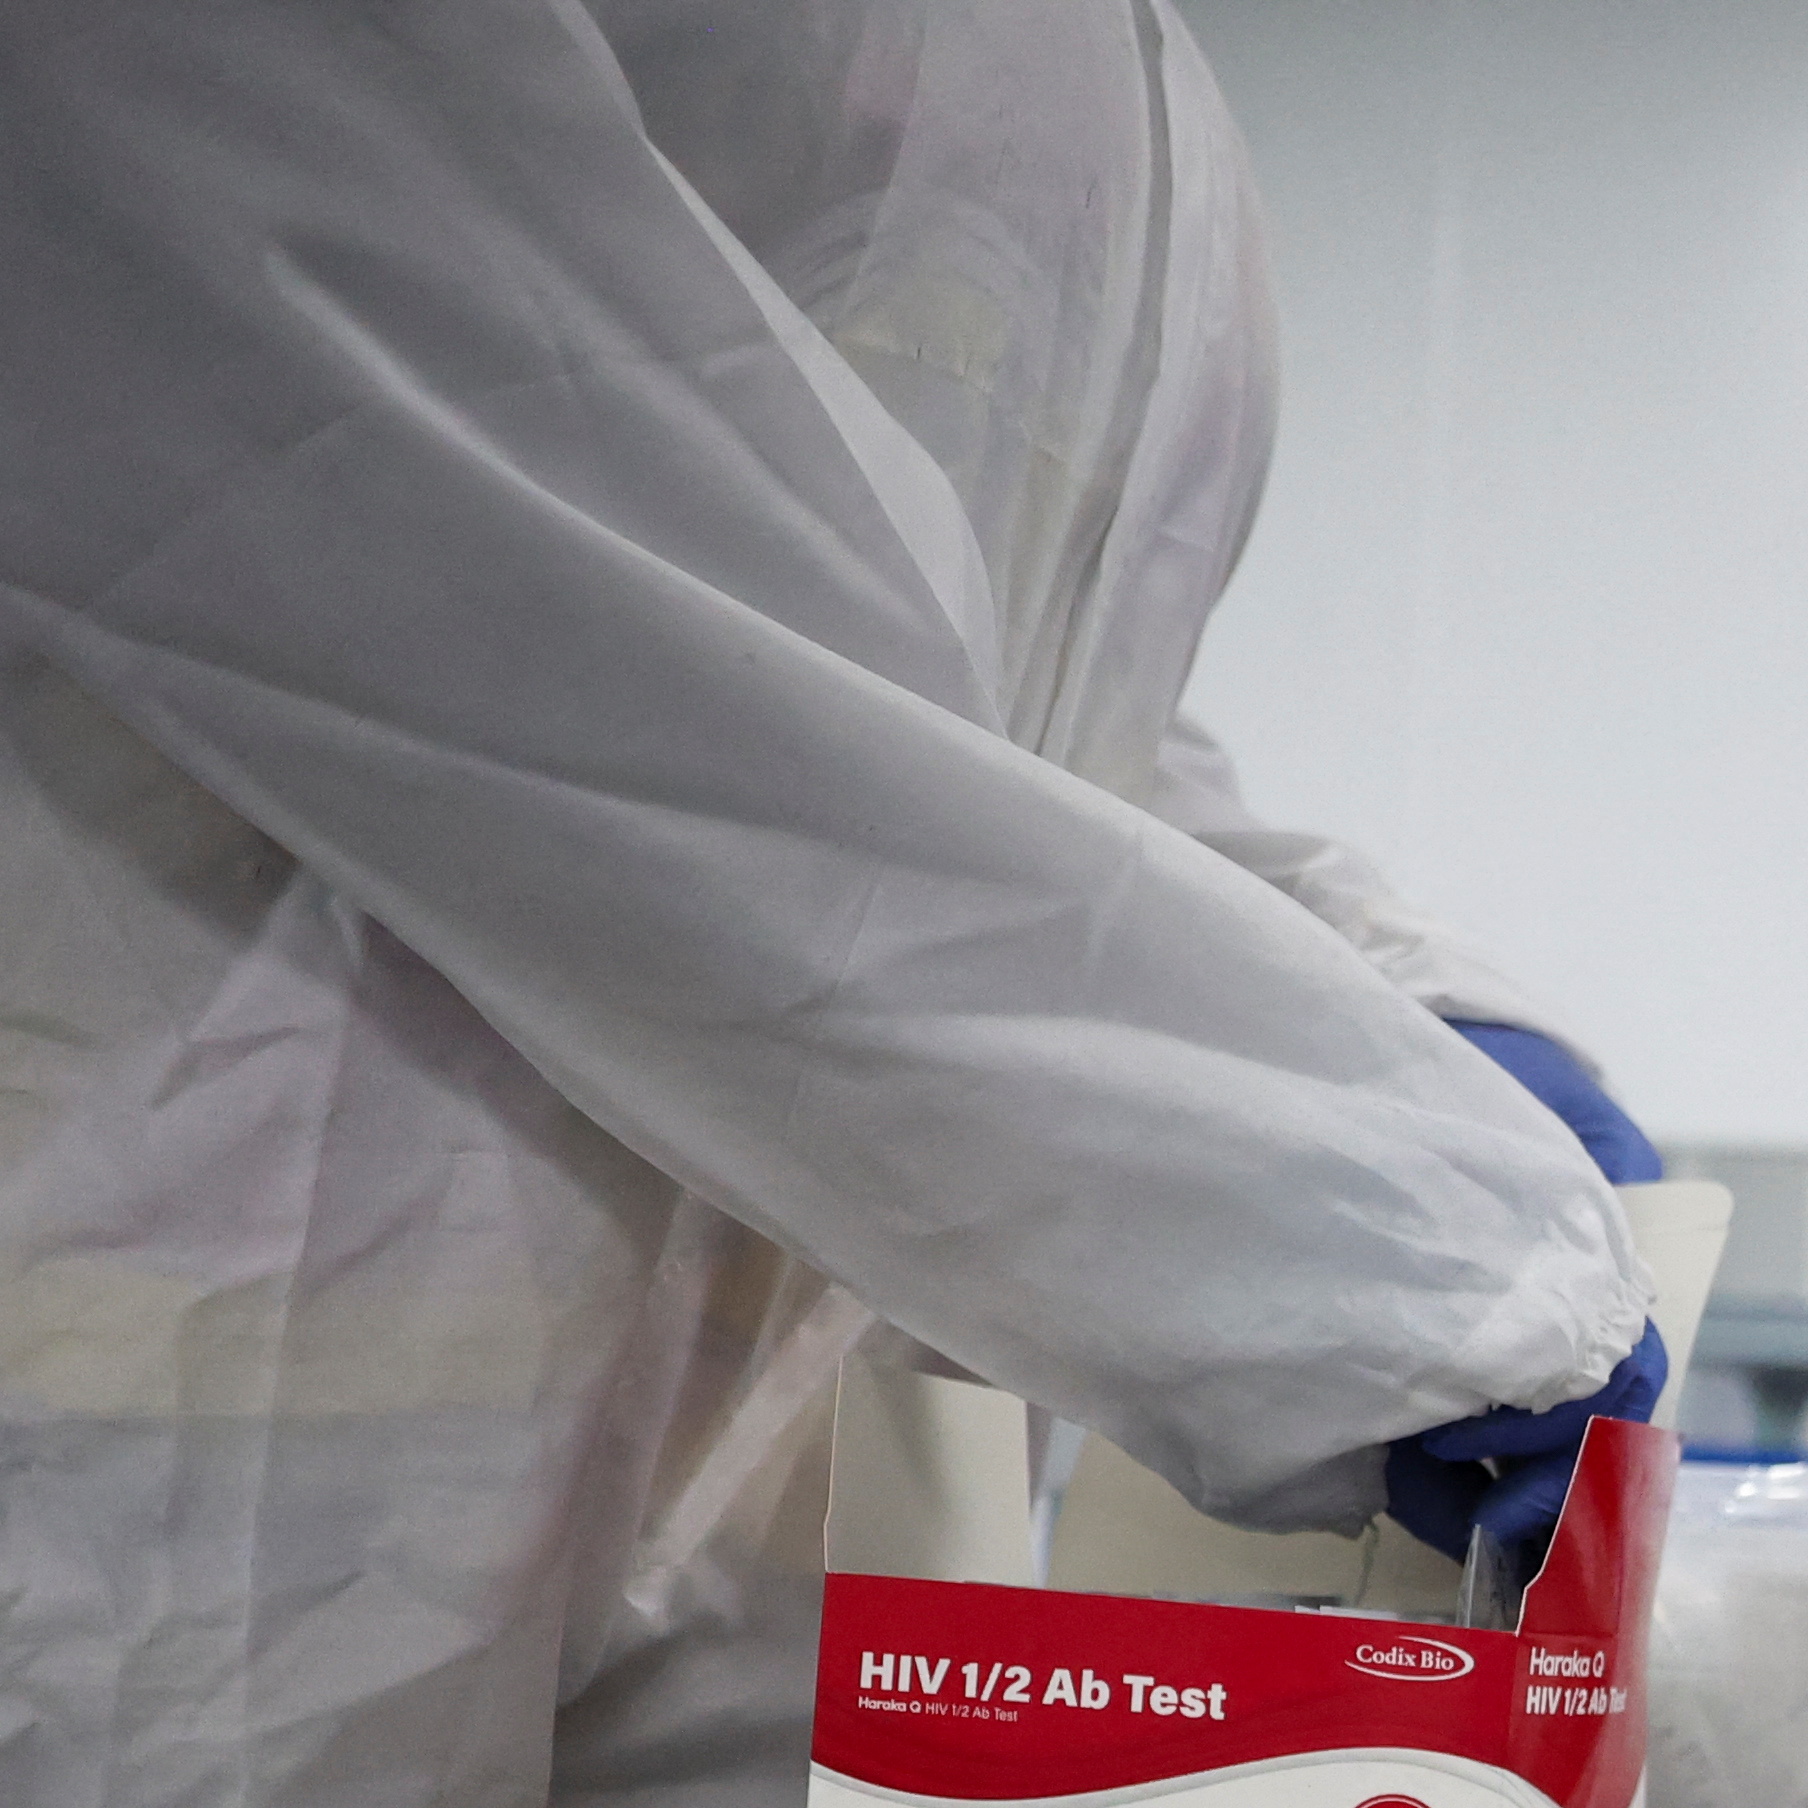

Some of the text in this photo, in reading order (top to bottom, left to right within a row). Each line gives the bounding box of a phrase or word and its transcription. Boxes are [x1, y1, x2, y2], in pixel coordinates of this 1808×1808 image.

[1355, 1644, 1455, 1671] Codix Bio
[1529, 1646, 1605, 1678] Haraka Q
[860, 1651, 1227, 1721] HIV 1/2 Ab Test
[1526, 1685, 1562, 1715] HIV
[1564, 1687, 1588, 1717] 1/2
[1588, 1686, 1608, 1716] Ab
[858, 1696, 1018, 1722] Haraka Q HIV 1/2 Ab Test
